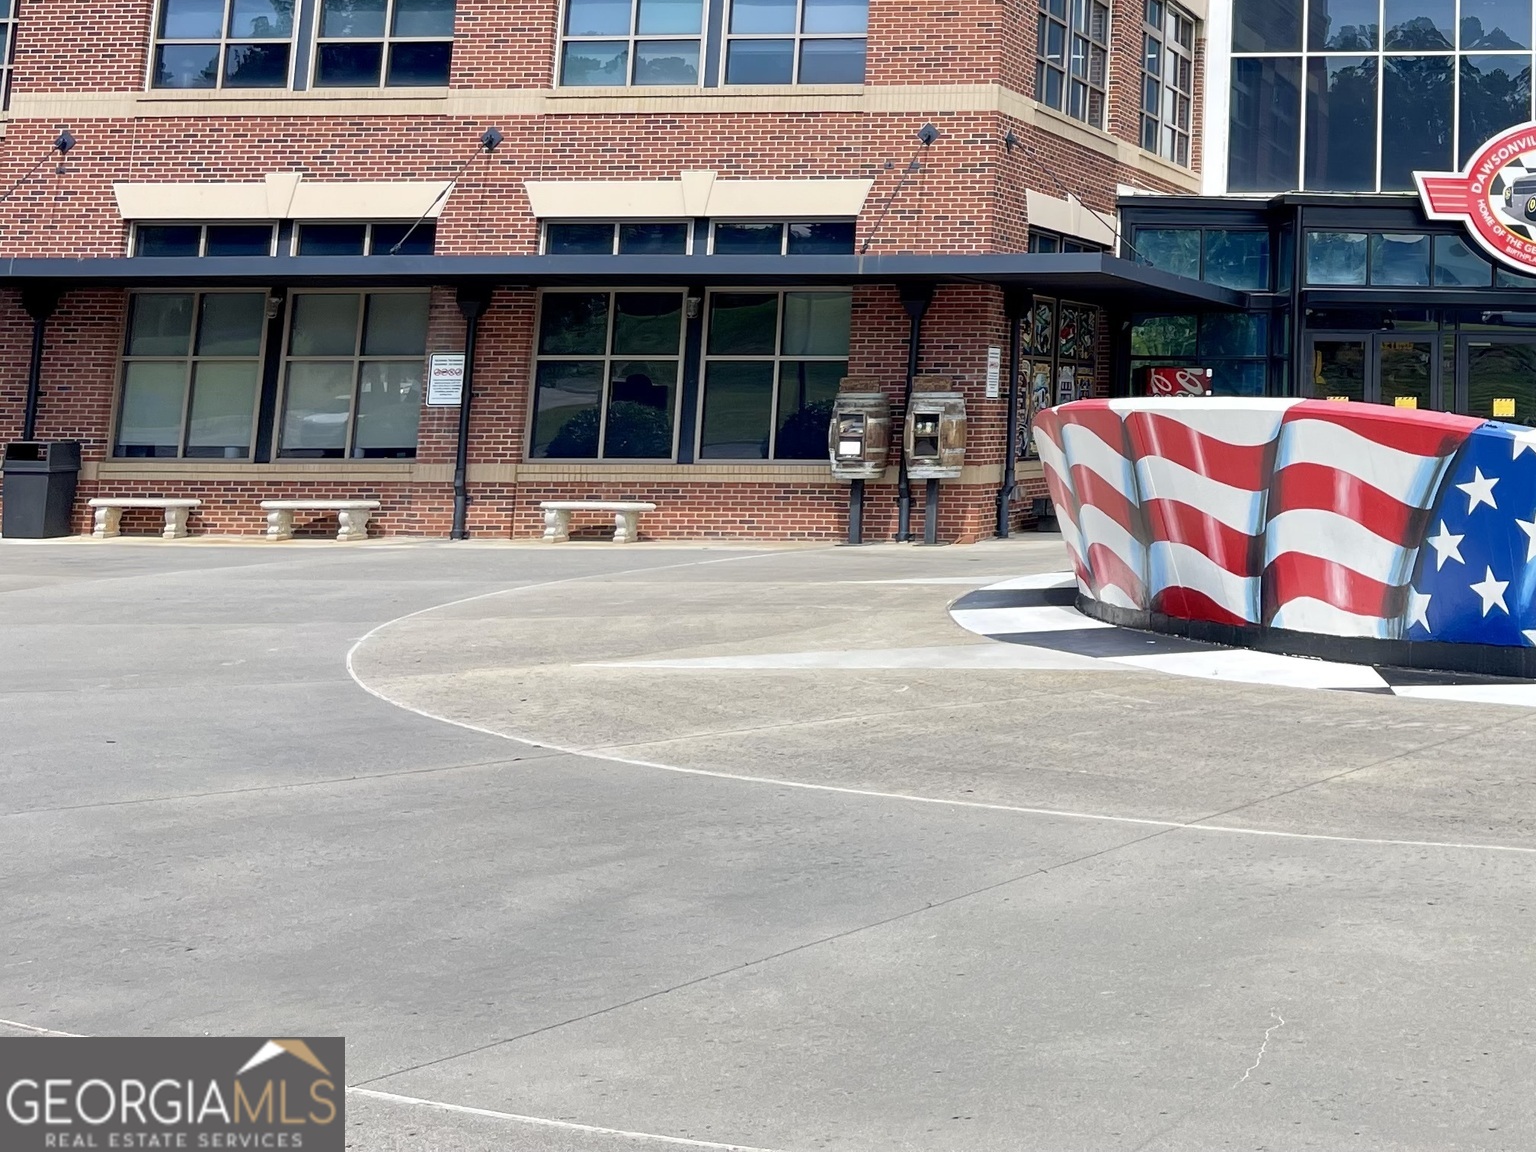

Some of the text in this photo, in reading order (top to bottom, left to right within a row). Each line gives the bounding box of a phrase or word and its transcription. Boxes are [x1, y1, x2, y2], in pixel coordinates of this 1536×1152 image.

[1477, 198, 1496, 227] HOME
[1493, 225, 1507, 237] OF
[1506, 234, 1523, 249] THE
